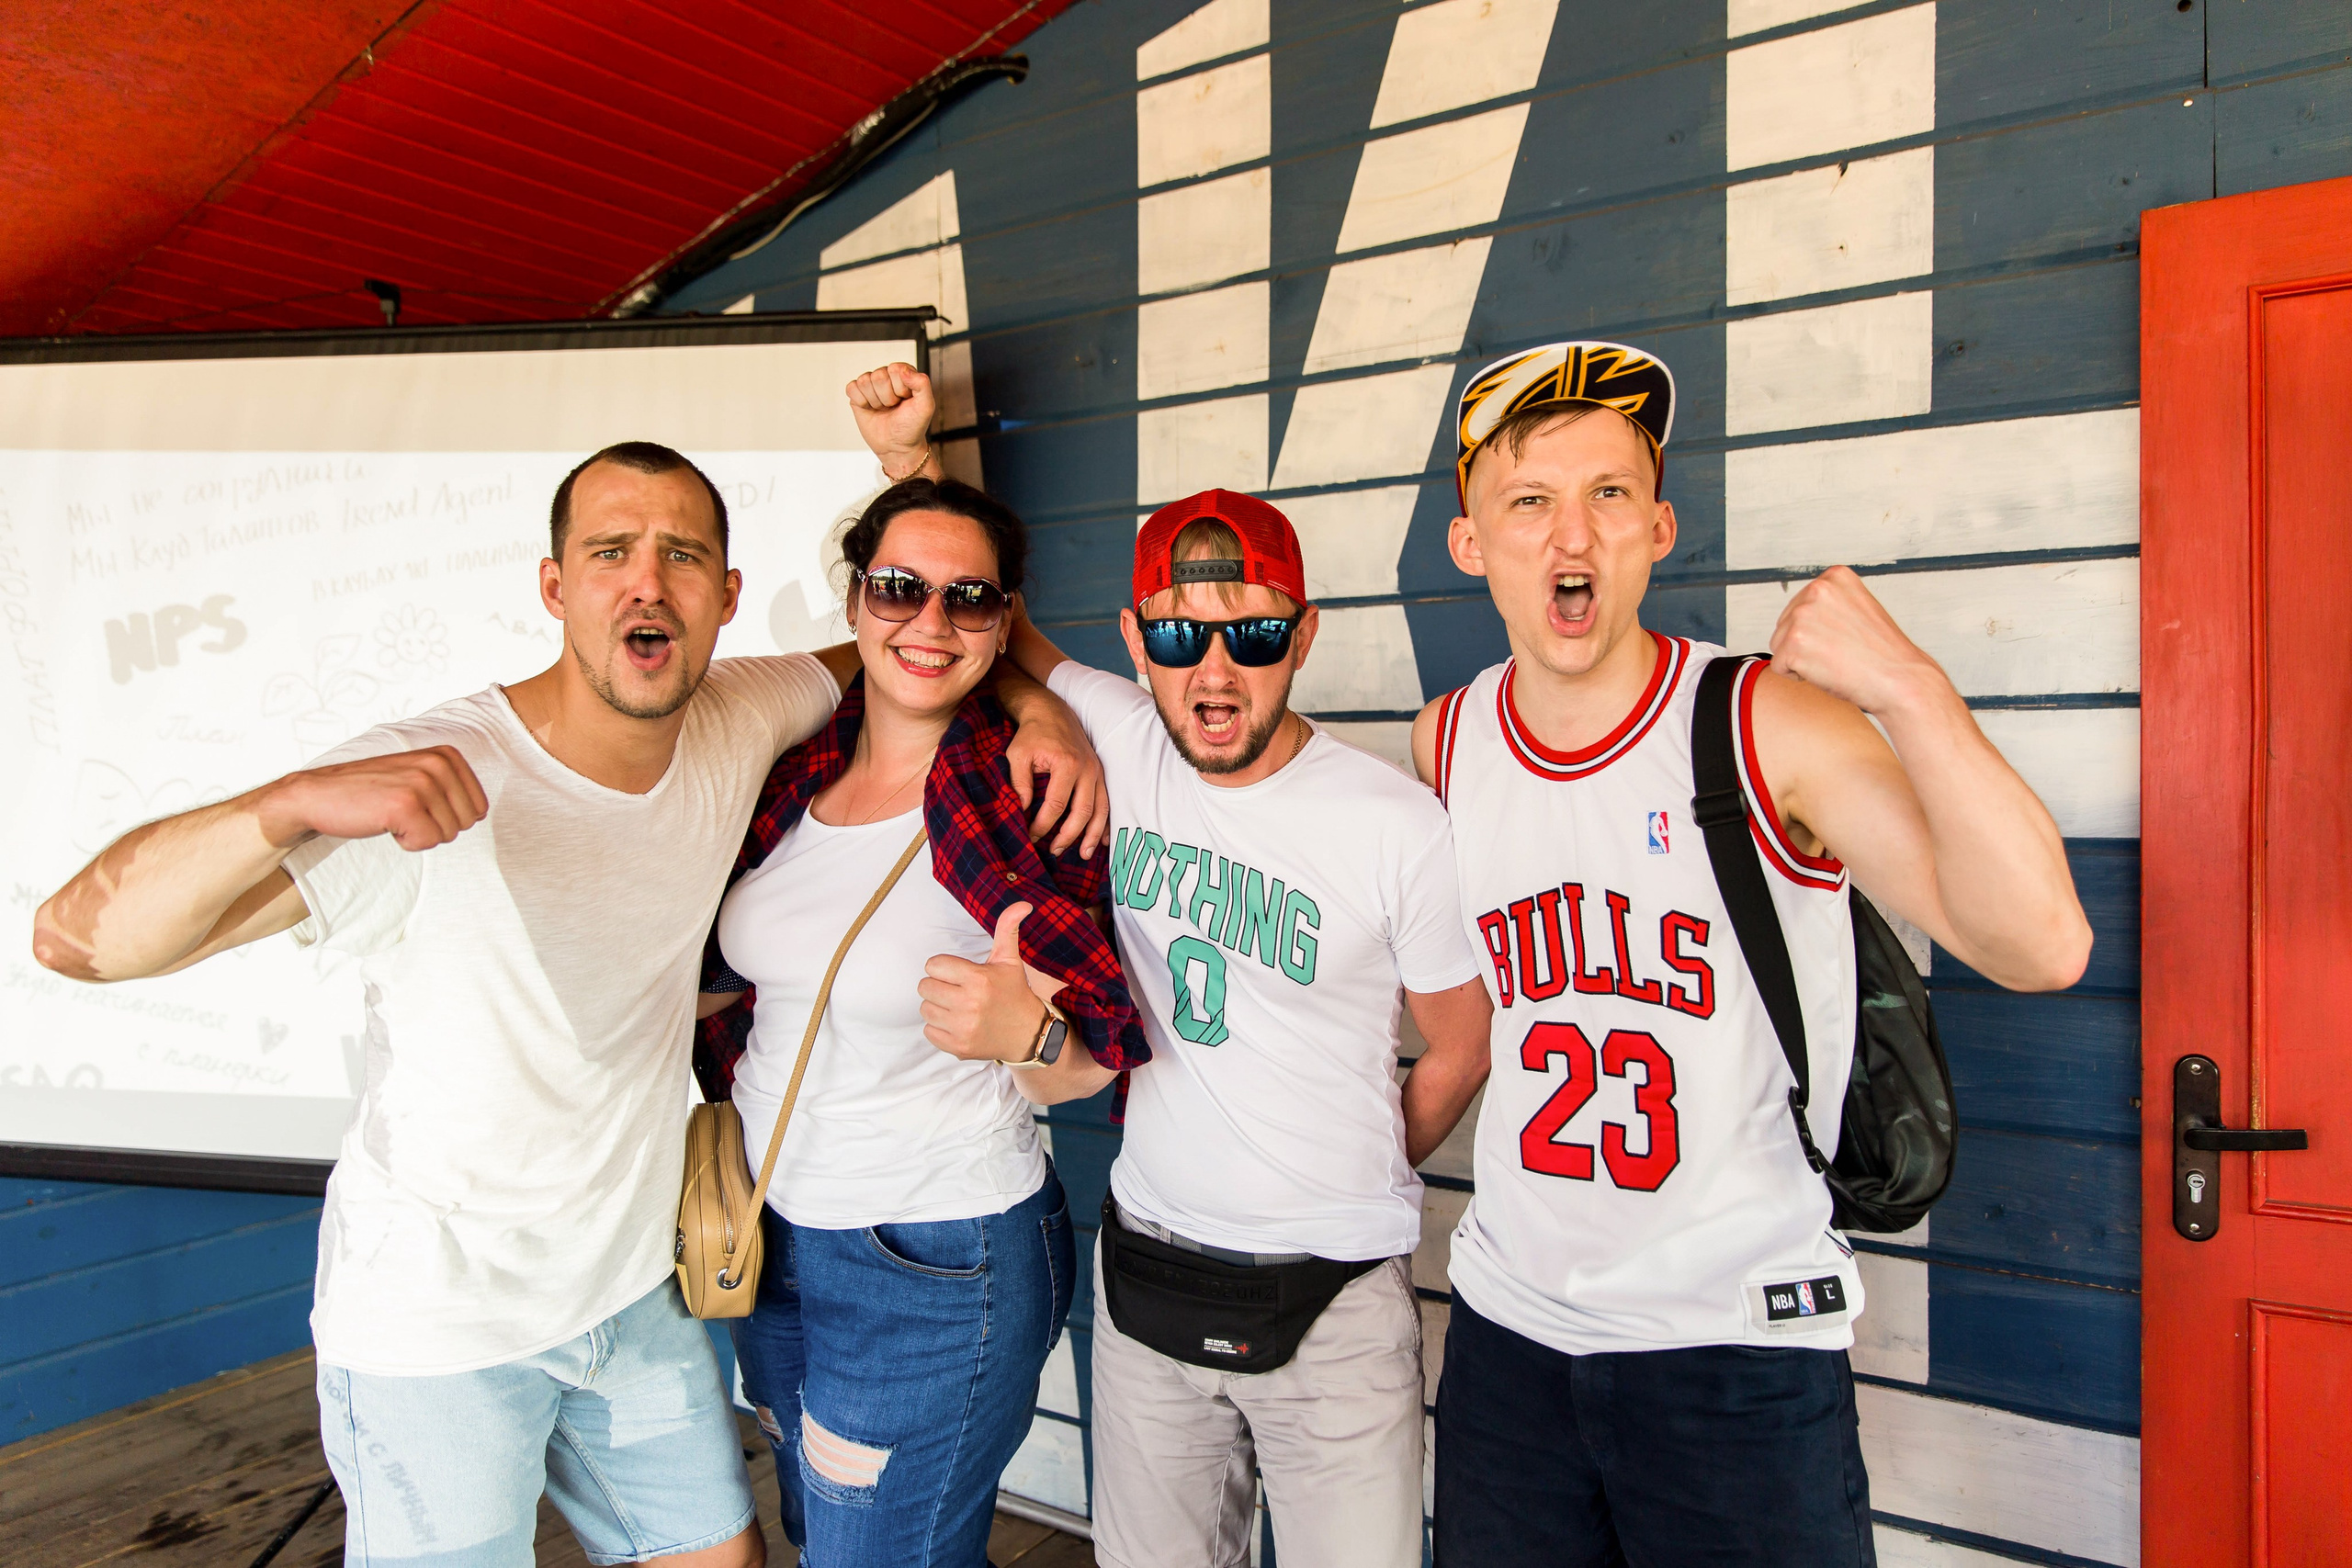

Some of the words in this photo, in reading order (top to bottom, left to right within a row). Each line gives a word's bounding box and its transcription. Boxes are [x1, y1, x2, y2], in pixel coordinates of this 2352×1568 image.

[430, 470, 517, 525] Agent
[103, 592, 248, 686] NPS
[1110, 827, 1321, 986] NOTHING
[1476, 882, 1716, 1021] BULLS
[1167, 934, 1229, 1047] 0
[1519, 1021, 1681, 1192] 23
[1771, 1293, 1795, 1311] NBA
[1826, 1289, 1836, 1300] L
